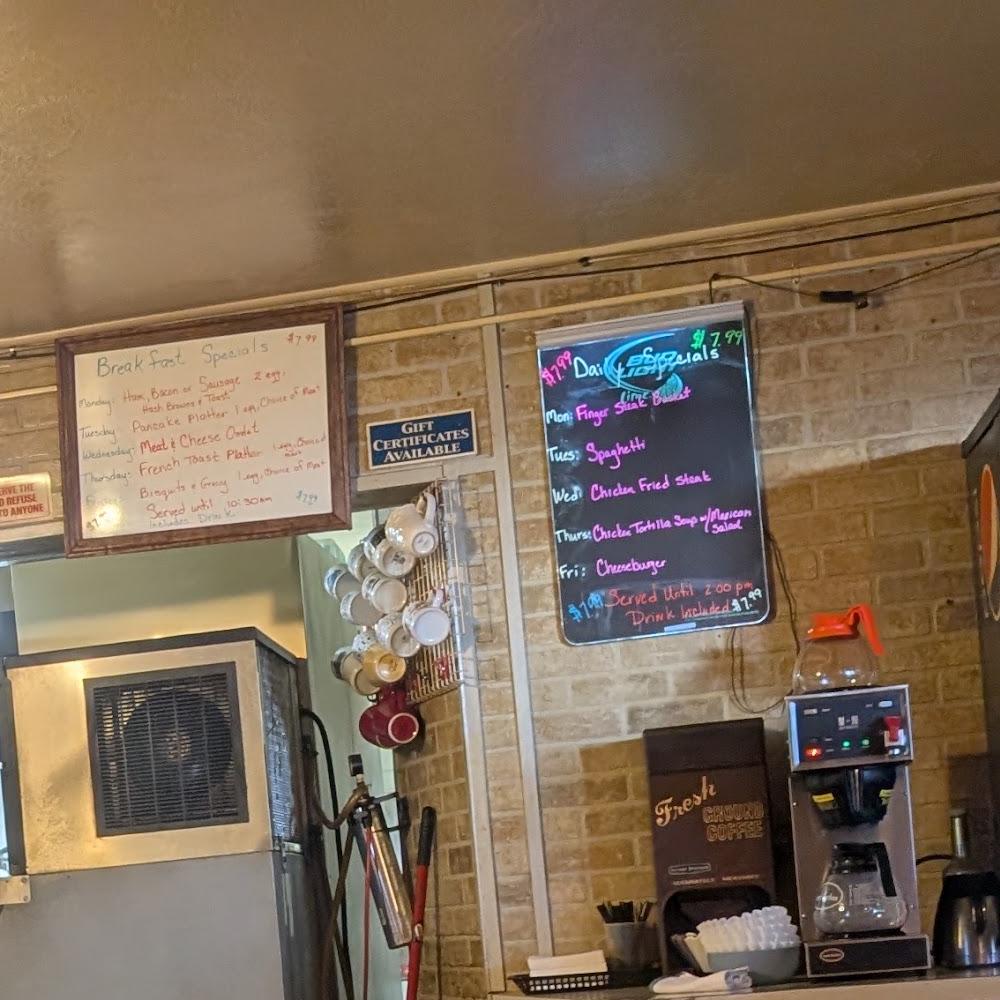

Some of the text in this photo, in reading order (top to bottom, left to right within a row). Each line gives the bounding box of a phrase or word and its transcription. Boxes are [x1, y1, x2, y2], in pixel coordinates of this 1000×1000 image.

[201, 336, 269, 368] Specials
[151, 387, 179, 400] Bacon
[200, 375, 241, 393] Sausage
[254, 371, 262, 381] 2
[203, 390, 231, 403] Toast
[132, 418, 181, 433] Pancake
[188, 407, 228, 424] Platter
[576, 403, 609, 427] Finger
[401, 420, 435, 434] GIFT
[140, 438, 168, 454] Meat
[180, 432, 221, 448] Cheese
[373, 428, 470, 452] CERTIFICATES
[139, 457, 180, 476] French
[184, 450, 220, 465] Toast
[383, 442, 462, 463] AVAILABLE
[586, 436, 646, 469] Spaghetti
[19, 482, 36, 493] THE
[590, 482, 635, 501] Chicken
[638, 473, 671, 492] Fried
[6, 493, 38, 505] REFUSE
[10, 503, 44, 517] ANYONE
[146, 501, 186, 520] Served
[191, 498, 213, 513] until
[674, 514, 698, 528] Soup
[596, 558, 668, 576] Cheeseburger
[604, 582, 657, 608] Served
[625, 604, 676, 627] Drink
[653, 775, 718, 827] Fresh
[706, 819, 764, 842] COFFEE
